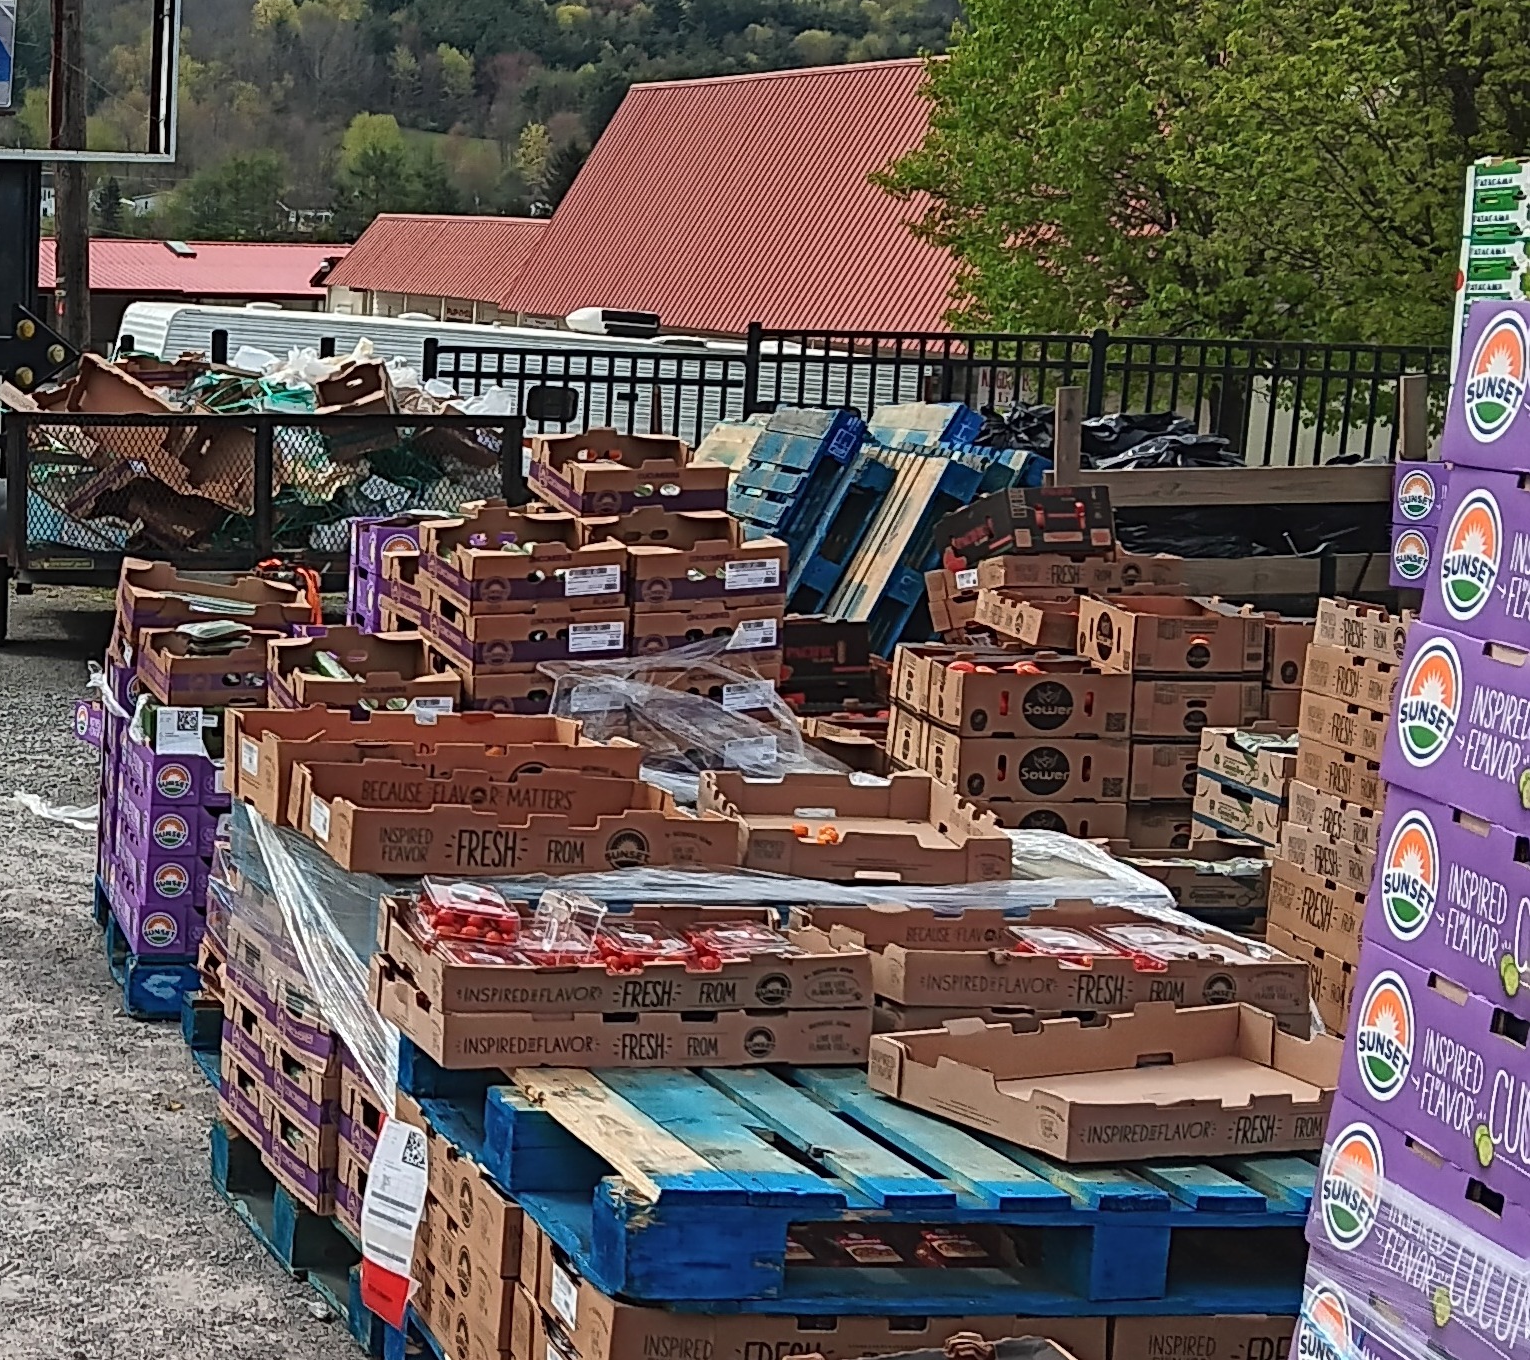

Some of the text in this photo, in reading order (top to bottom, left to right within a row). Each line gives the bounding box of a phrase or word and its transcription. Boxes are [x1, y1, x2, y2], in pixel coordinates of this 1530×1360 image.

[1466, 376, 1523, 409] SUNSET
[1399, 495, 1434, 507] SUNSET
[1050, 564, 1081, 585] FRESH
[1395, 554, 1428, 566] SUNSET
[1442, 554, 1496, 588] SUNSET
[1336, 666, 1360, 698] FRESH
[1023, 702, 1073, 716] Sower
[1400, 701, 1455, 736] SUNSET
[1469, 685, 1530, 740] INSPIRED
[1331, 713, 1355, 746] FRESH
[1464, 728, 1521, 784] FLAVOR
[1020, 767, 1071, 781] Sower
[1328, 761, 1352, 795] FRESH
[361, 780, 422, 802] BECAUSE
[506, 788, 574, 811] MATTERS
[379, 827, 433, 845] INSPIRED
[455, 830, 650, 868] FRESH FROM SUNSET
[381, 844, 429, 863] FLAVOR
[1313, 844, 1339, 878] FRESH
[1384, 872, 1435, 912] SUNSET
[1447, 862, 1507, 926] INSPIRED
[1300, 886, 1334, 933] FRESH
[144, 927, 176, 937] SUNSET
[1444, 907, 1499, 970] FLAVOR
[464, 986, 529, 1003] INSPIRED
[537, 985, 600, 1003] FLAVOR
[622, 980, 673, 1007] FRESH
[698, 982, 736, 1004] FROM
[926, 974, 987, 993] INSPIRED
[997, 976, 1054, 994] FLAVOR
[1077, 974, 1125, 1006] FRESH
[1150, 980, 1185, 1004] FROM
[464, 1038, 527, 1055] INSPIRED
[537, 1036, 594, 1054] FLAVOR
[621, 1036, 664, 1060] FRESH
[687, 1036, 719, 1057] FROM
[1358, 1030, 1410, 1074] SUNSET
[1422, 1027, 1484, 1095] INSPIRED
[1420, 1072, 1475, 1138] FLAVOR
[1087, 1114, 1323, 1145] INSPIRED FLAVOR FRESH FROM
[644, 1334, 713, 1360] INSPIRED
[1148, 1334, 1216, 1357] INSPIRED
